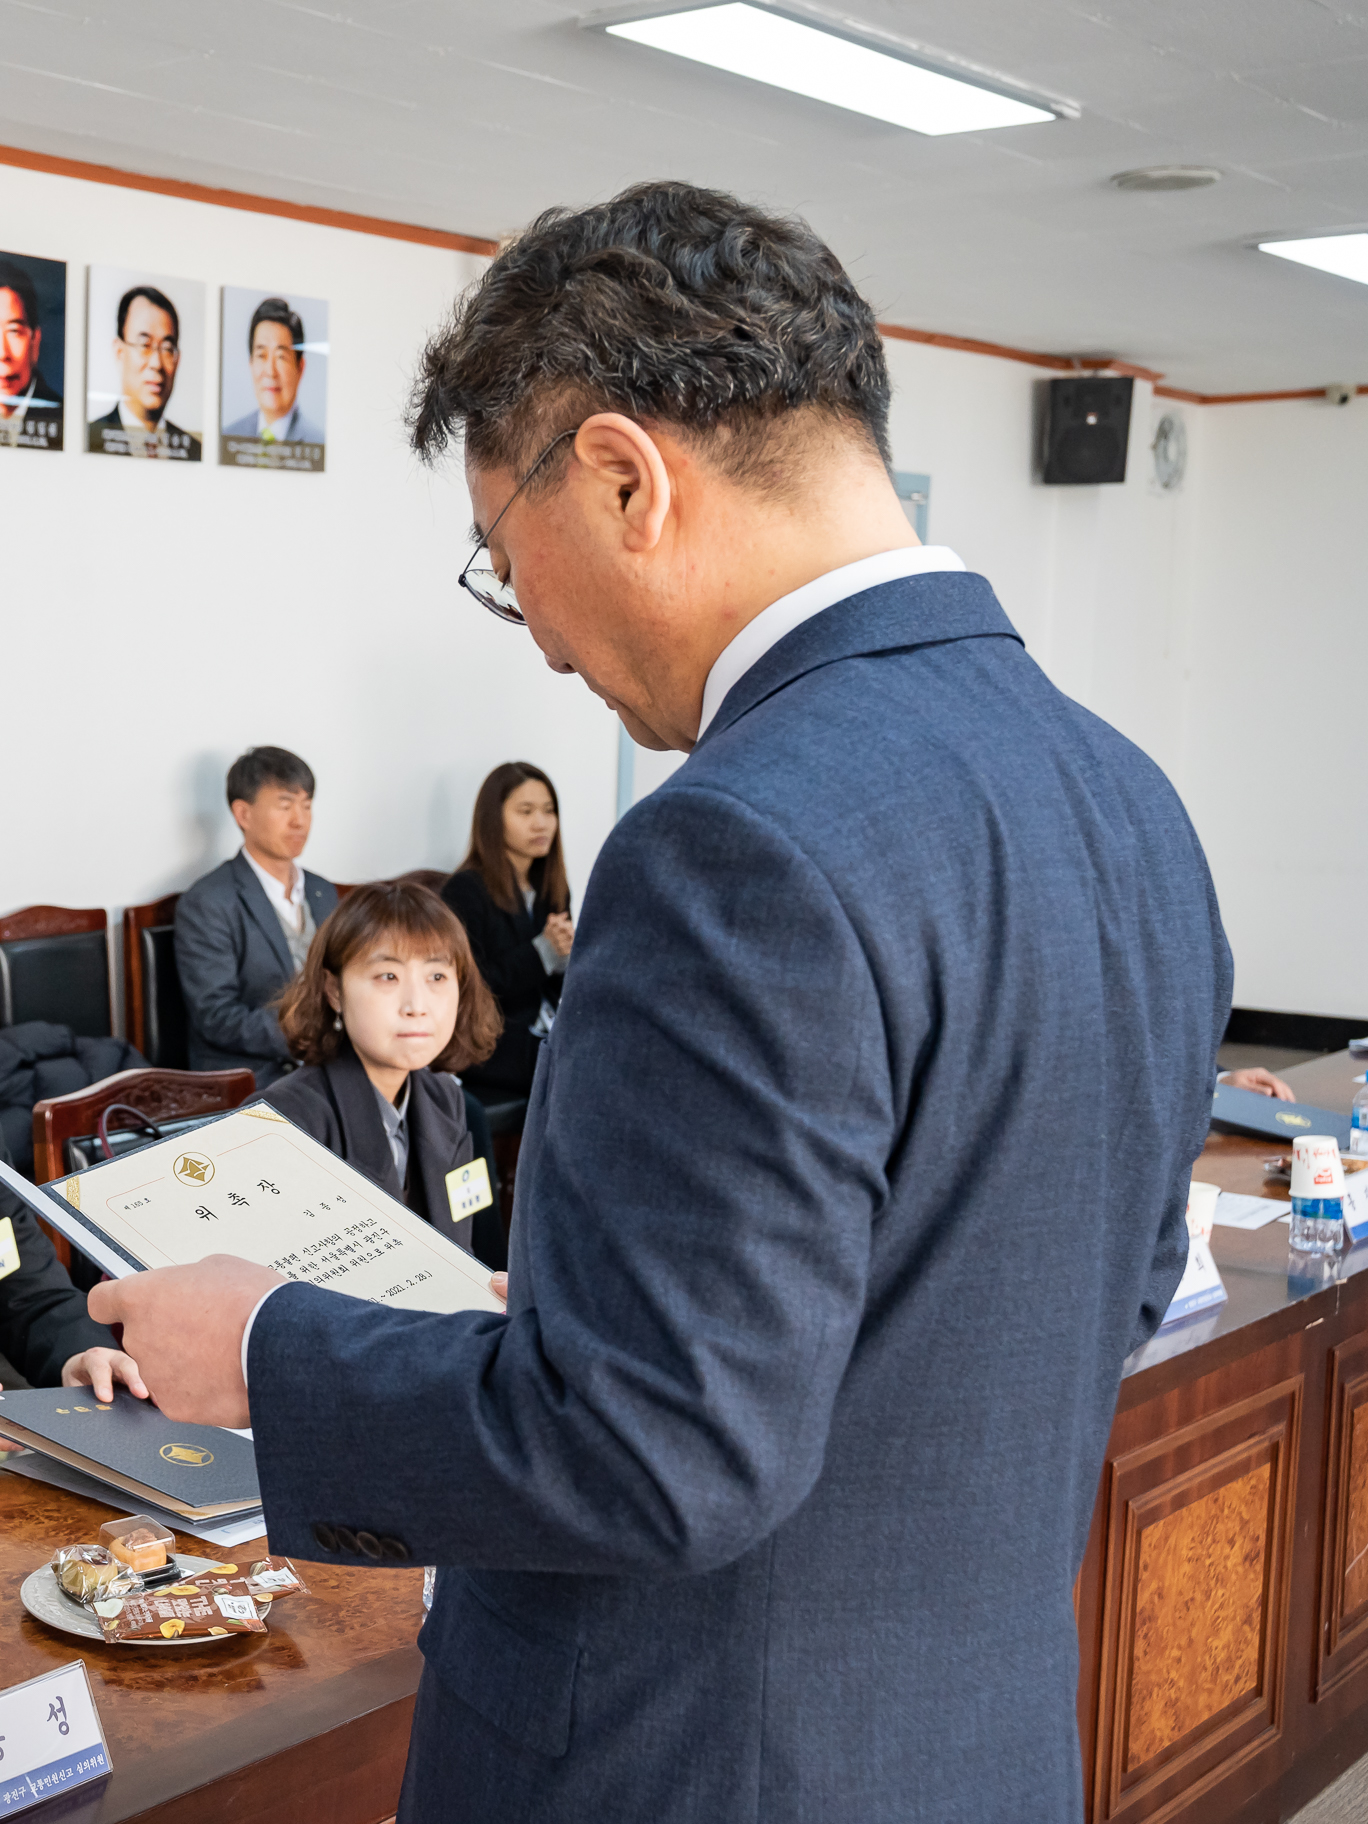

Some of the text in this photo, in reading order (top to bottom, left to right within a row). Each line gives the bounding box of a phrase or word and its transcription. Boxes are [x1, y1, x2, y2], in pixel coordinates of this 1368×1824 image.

[195, 1179, 281, 1221] 위 촉 장
[343, 1217, 378, 1237] 공정하고
[299, 1261, 320, 1275] 위한
[320, 1240, 364, 1264] 서울특별시
[363, 1227, 391, 1245] 광진구
[349, 1248, 385, 1268] 위원으로
[383, 1238, 404, 1251] 위촉
[189, 1595, 213, 1616] THE
[46, 1695, 70, 1736] 성
[2, 1753, 105, 1805] 광진구 교통민원신고 심의위원
